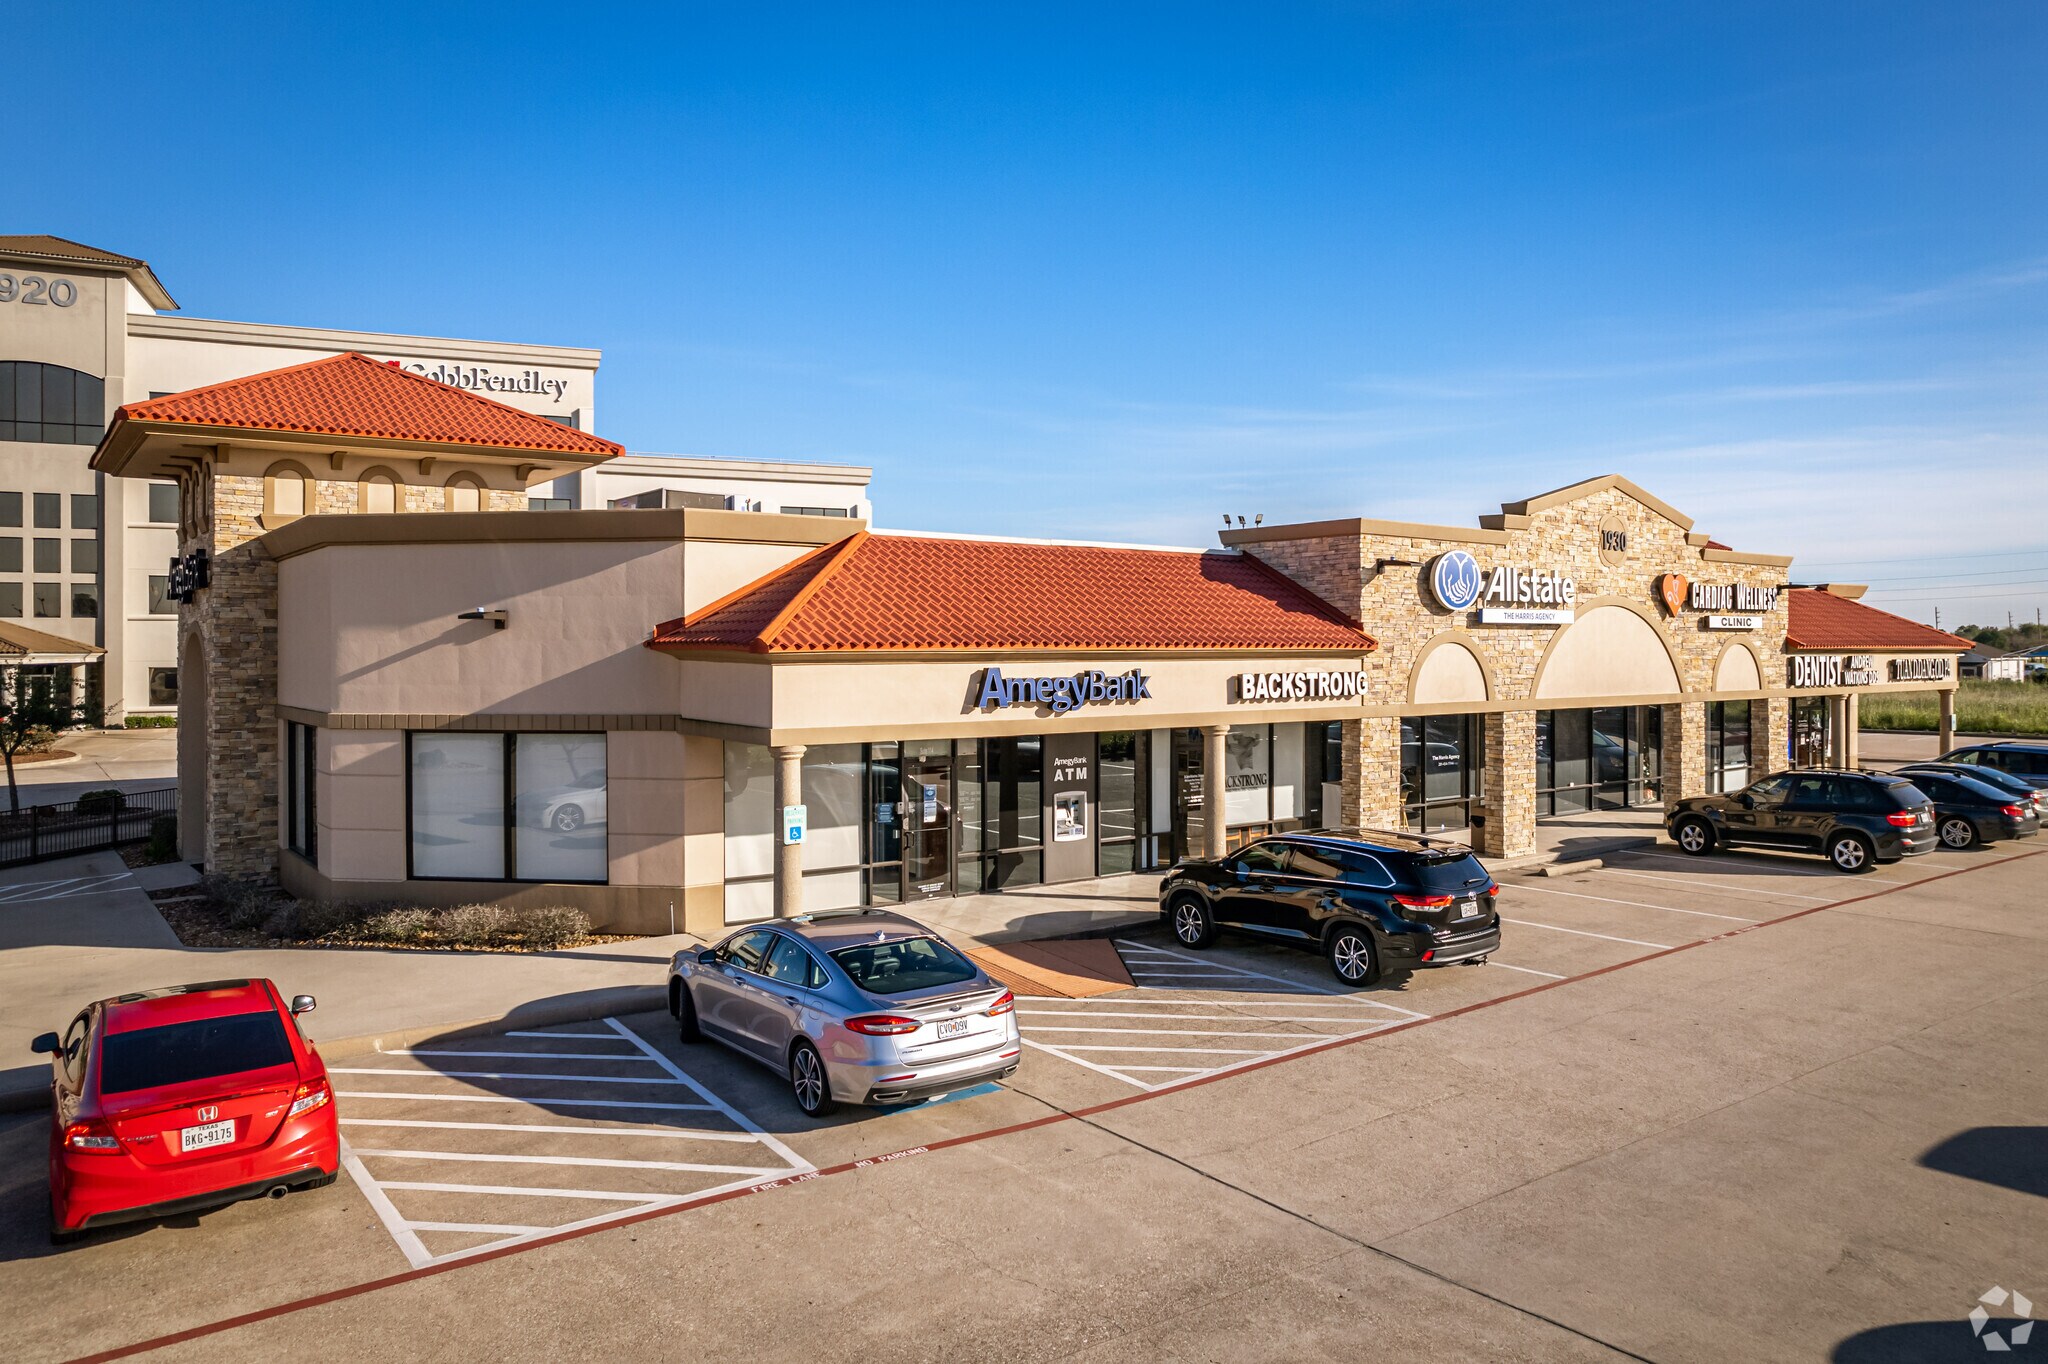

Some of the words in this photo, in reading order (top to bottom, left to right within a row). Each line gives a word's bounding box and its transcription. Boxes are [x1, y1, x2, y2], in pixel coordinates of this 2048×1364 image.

[0, 274, 78, 308] 920
[1601, 530, 1627, 552] 1930
[1485, 566, 1575, 604] Allstate
[1504, 612, 1515, 620] THE
[1515, 612, 1535, 620] HARRIS
[1535, 612, 1556, 621] AGENCY
[1721, 617, 1752, 627] CLINIC
[1794, 656, 1843, 687] DENTIST
[1844, 670, 1868, 685] WATKINS
[978, 667, 1152, 713] AmegyBank
[1242, 671, 1369, 700] BACKSTRONG
[1053, 757, 1087, 767] AmegyBank
[1053, 767, 1087, 781] ATM
[1225, 773, 1267, 788] CKSTRONG
[751, 1182, 784, 1193] FIRE
[789, 1171, 825, 1184] LANE
[855, 1159, 874, 1169] NO
[878, 1146, 928, 1163] PARKING
